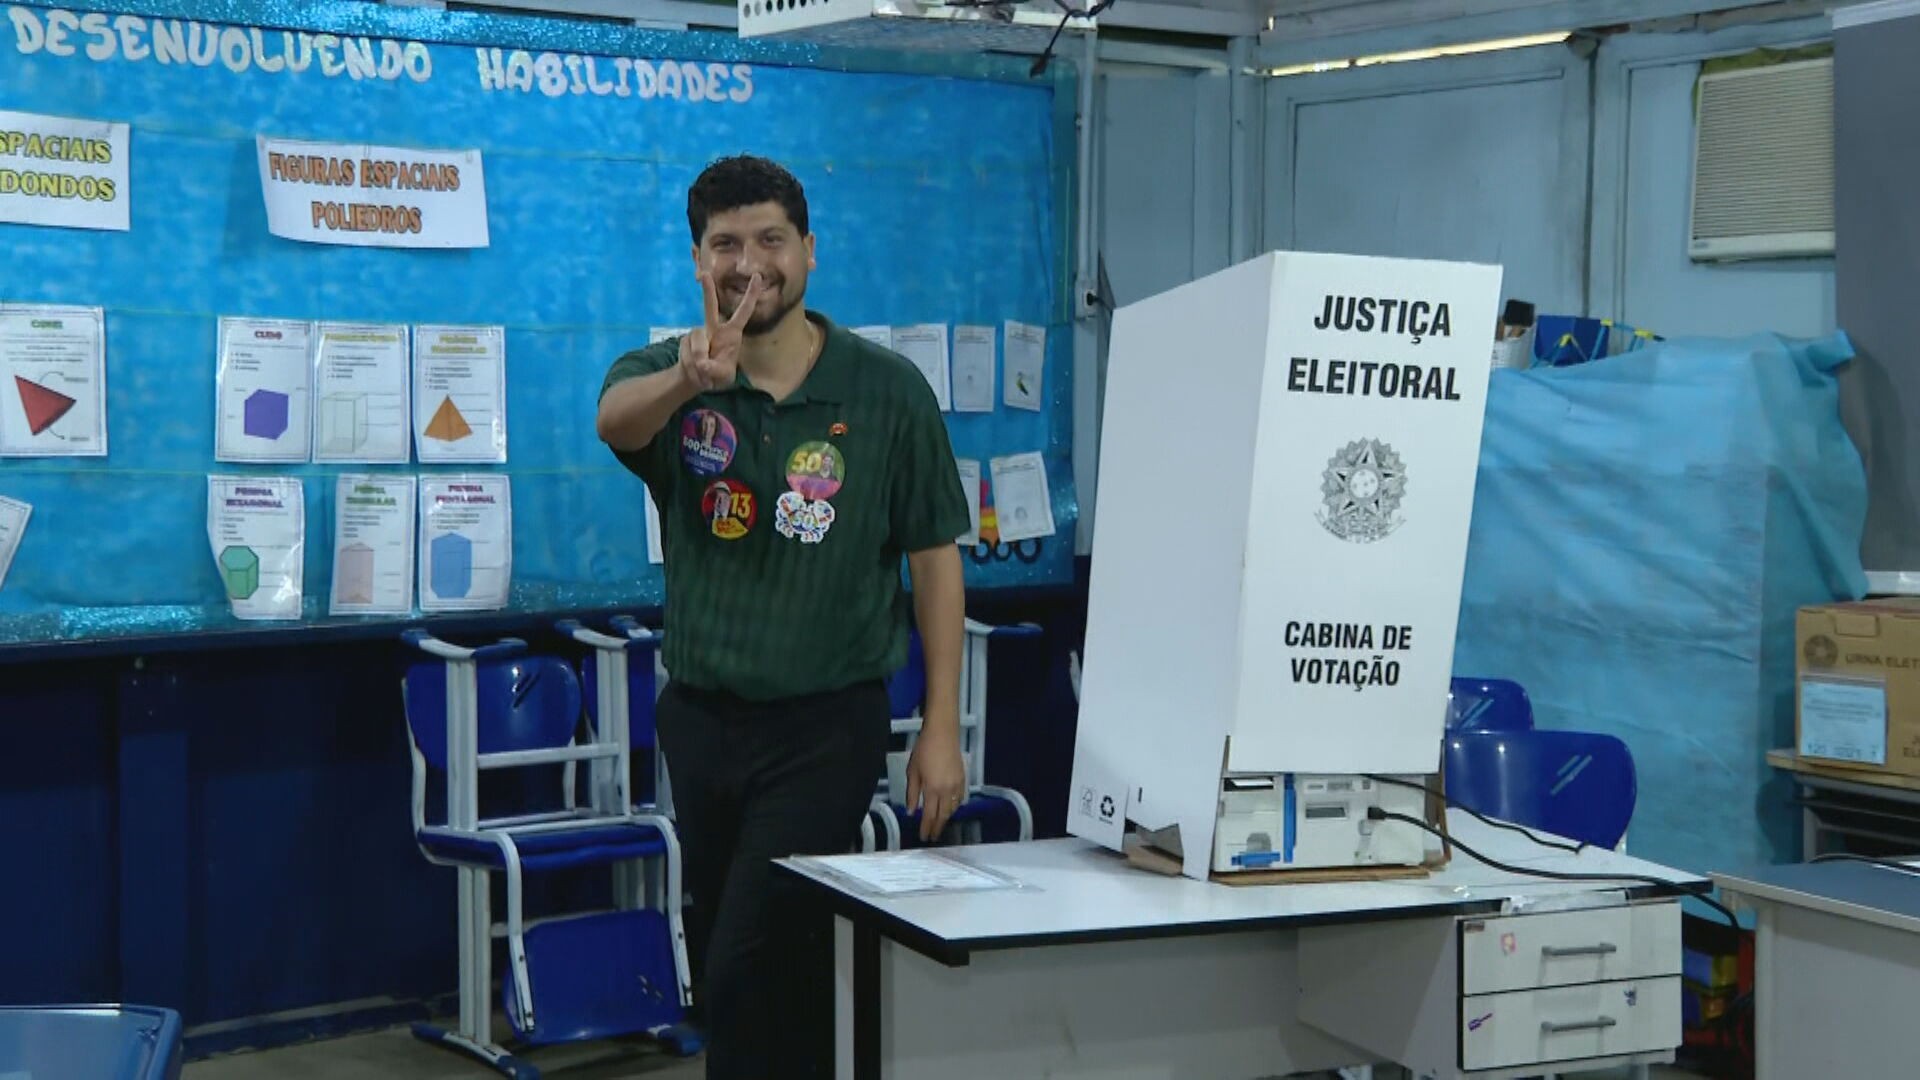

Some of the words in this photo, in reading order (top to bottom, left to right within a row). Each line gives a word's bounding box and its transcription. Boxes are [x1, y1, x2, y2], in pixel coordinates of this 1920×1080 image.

[475, 47, 754, 103] HABILIDADES
[0, 169, 116, 202] DONDOS
[269, 151, 355, 187] FIGURAS
[360, 158, 460, 192] ESPACIAIS
[311, 201, 422, 234] POLIEDROS
[1314, 294, 1451, 344] JUSTIÇA
[1287, 356, 1461, 401] ELEITORAL
[791, 450, 822, 473] 50
[731, 492, 752, 519] 13
[1284, 621, 1374, 649] CABINA
[1382, 624, 1413, 651] DE
[1291, 655, 1400, 692] VOTAÇÃO
